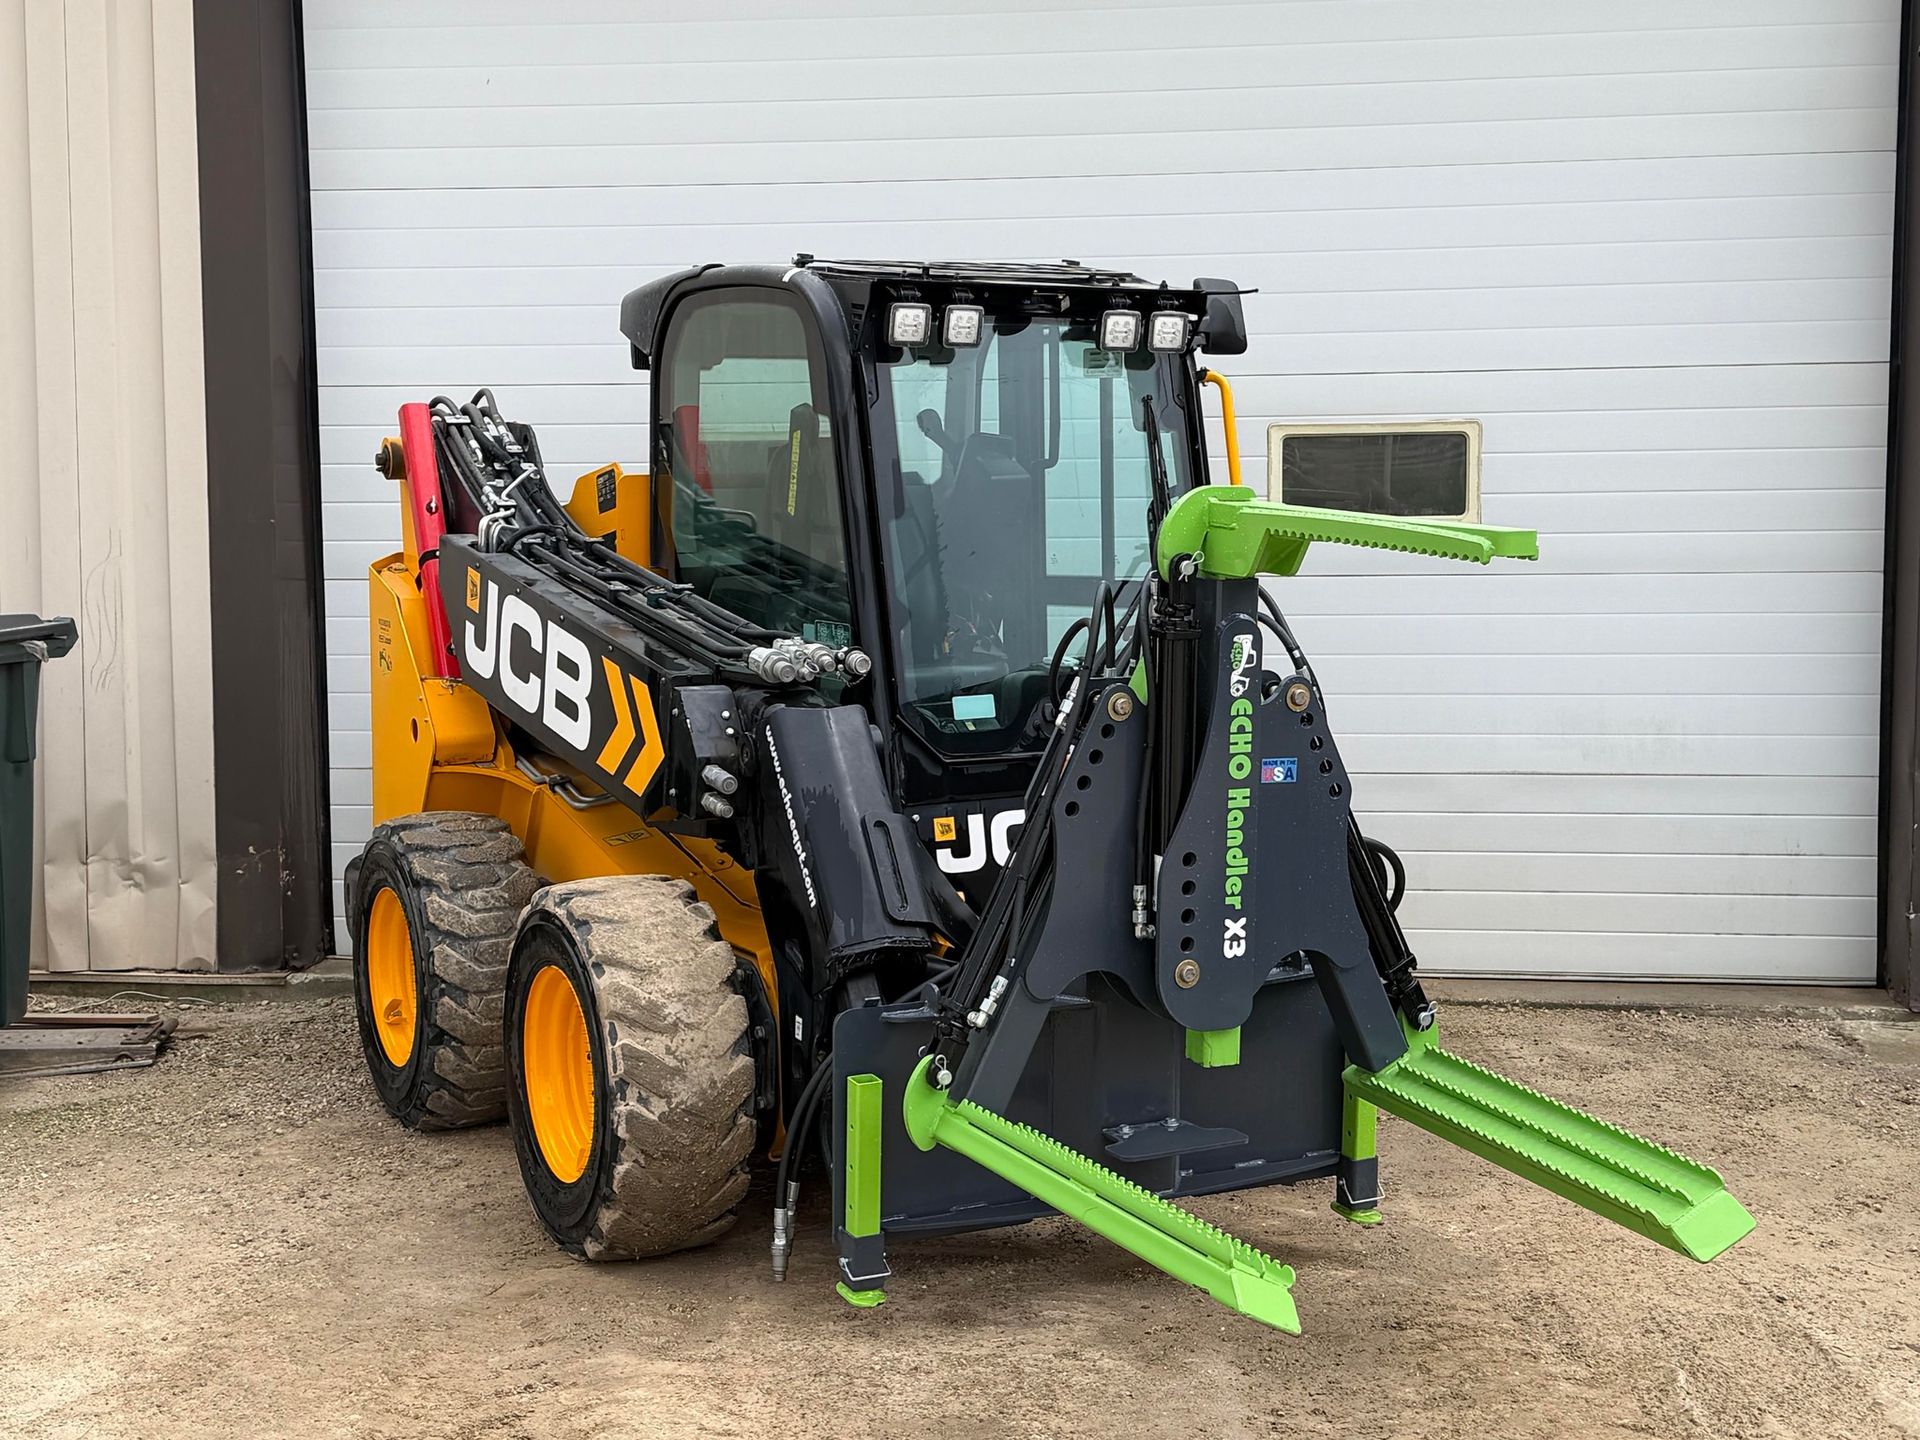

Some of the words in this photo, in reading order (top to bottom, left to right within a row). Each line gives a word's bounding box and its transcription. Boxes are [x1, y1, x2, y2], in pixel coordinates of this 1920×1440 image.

[464, 579, 593, 751] JCB
[1228, 698, 1253, 780] ECHO
[1262, 766, 1295, 782] USA
[764, 724, 818, 908] www.echoeqpt.com
[936, 809, 1026, 874] JC
[1224, 787, 1252, 911] Handler
[1223, 917, 1246, 959] X3
